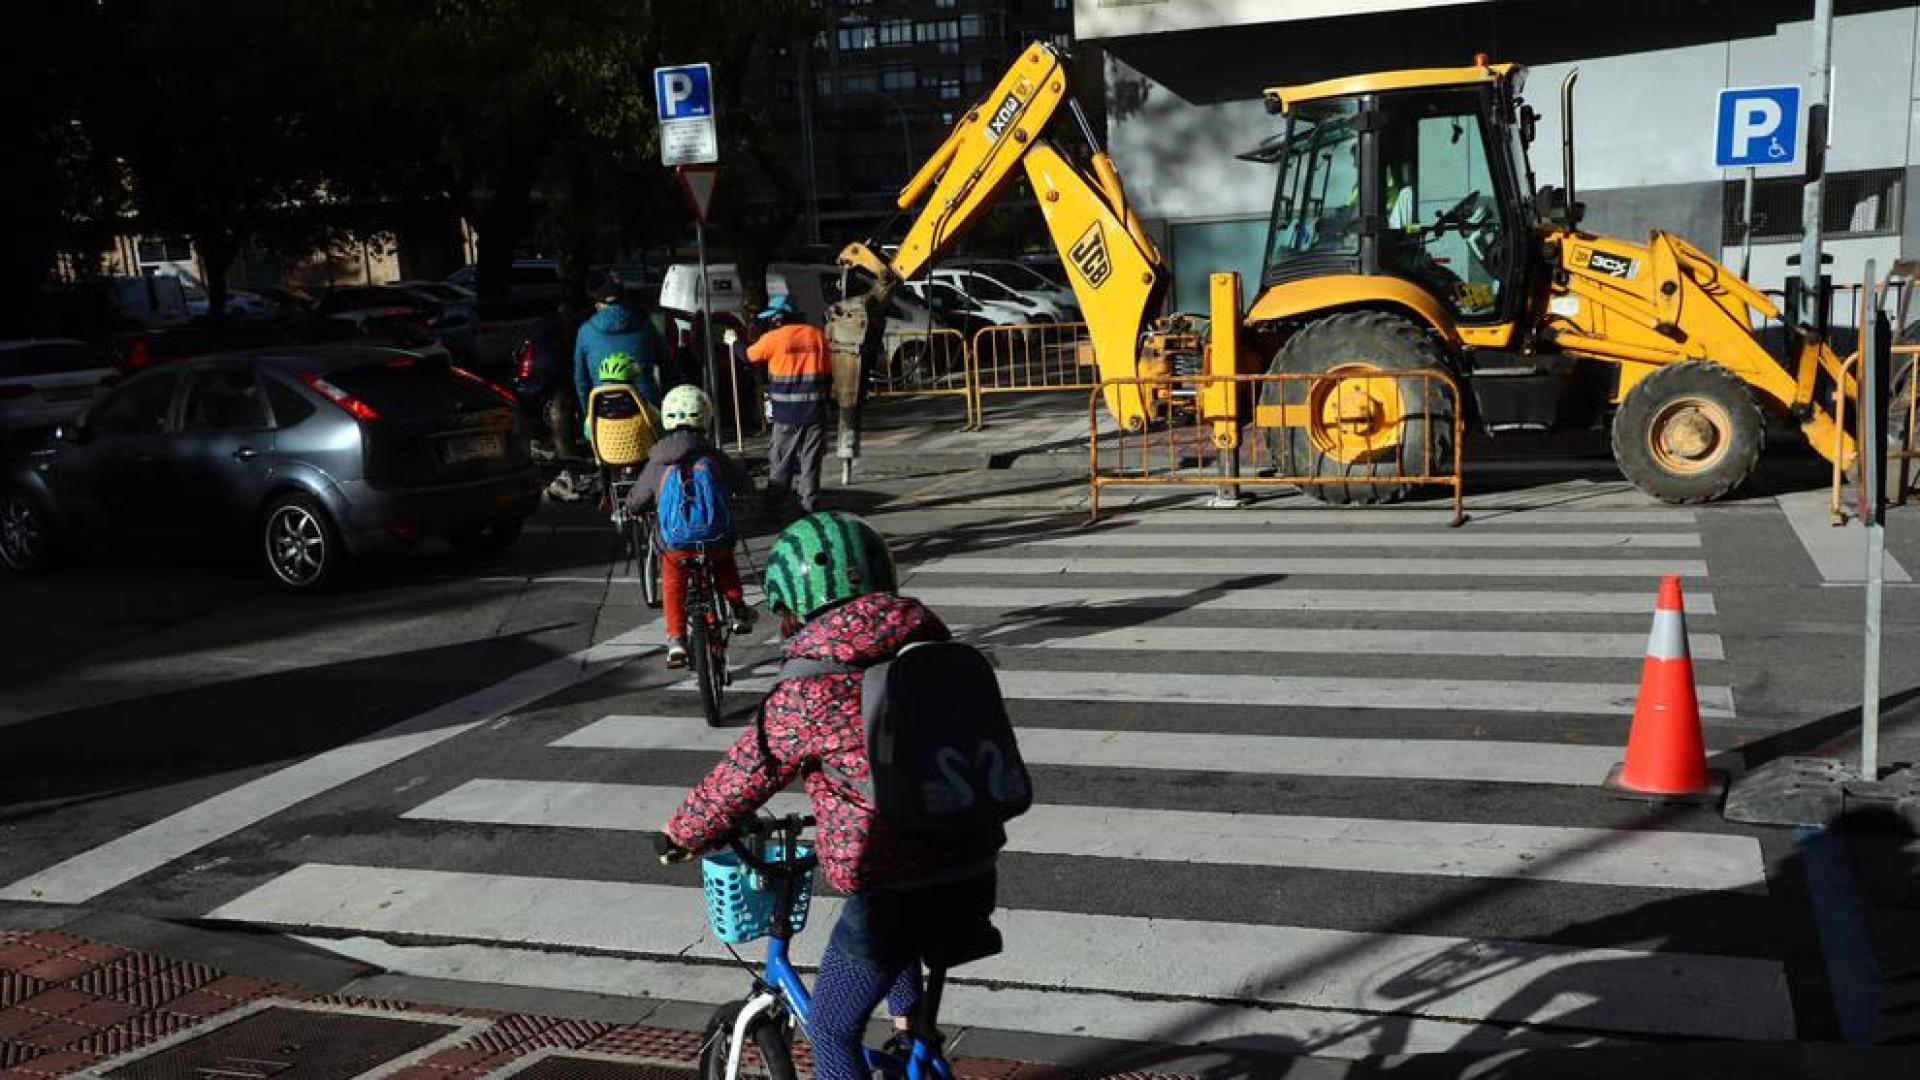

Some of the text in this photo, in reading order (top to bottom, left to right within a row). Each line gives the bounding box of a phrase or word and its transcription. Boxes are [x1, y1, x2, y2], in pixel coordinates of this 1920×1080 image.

[664, 74, 692, 115] P
[1732, 97, 1781, 157] P
[1071, 231, 1108, 284] JCB
